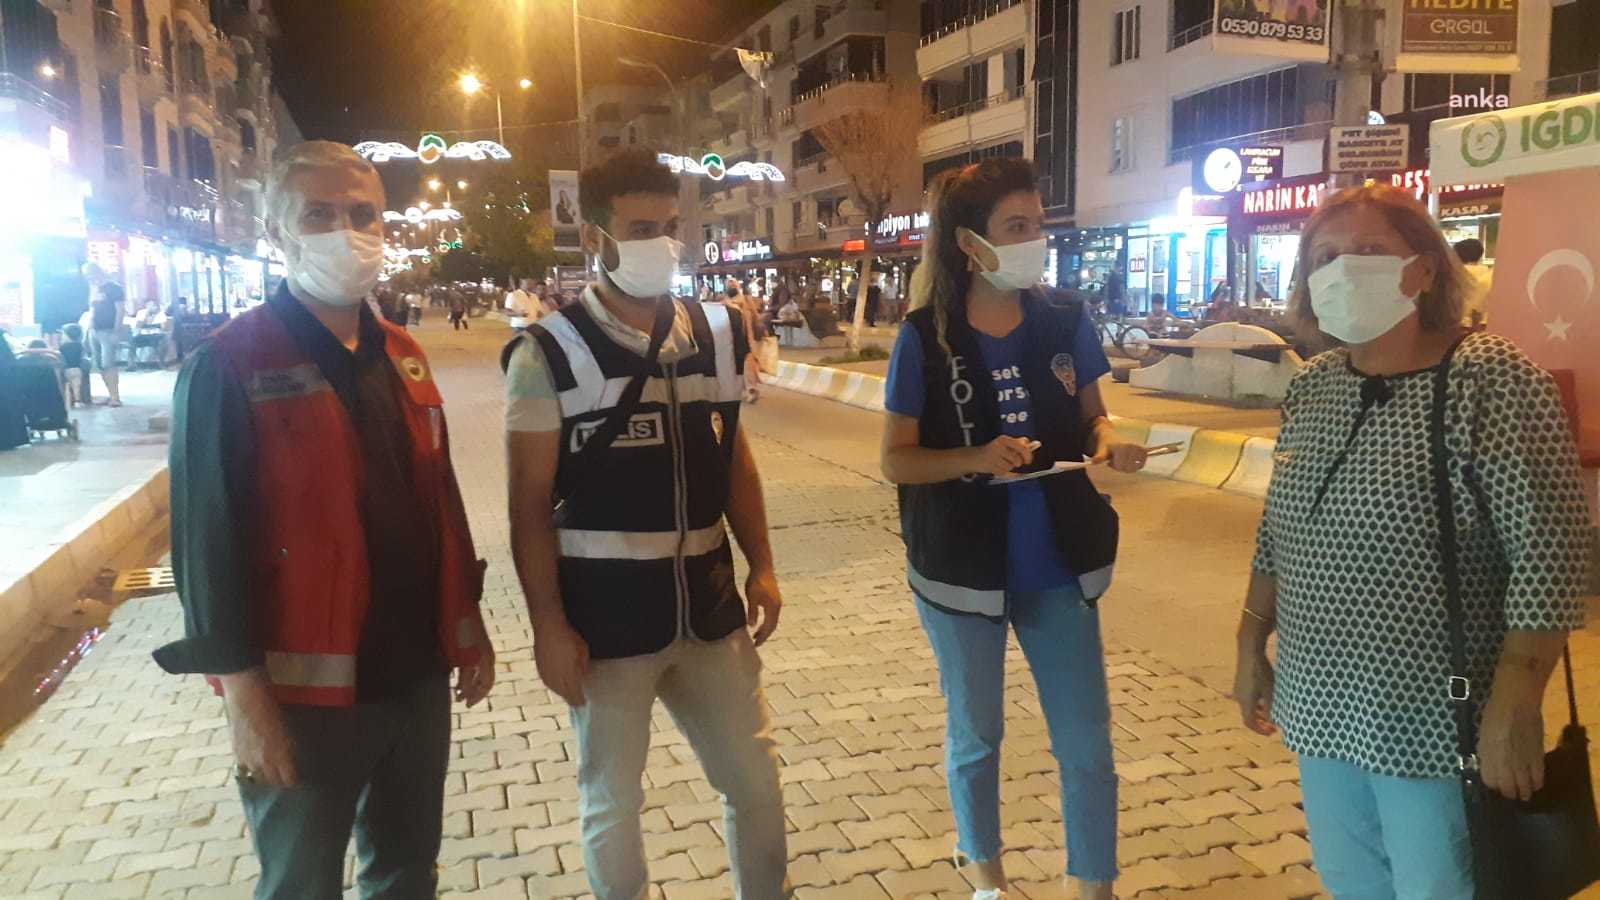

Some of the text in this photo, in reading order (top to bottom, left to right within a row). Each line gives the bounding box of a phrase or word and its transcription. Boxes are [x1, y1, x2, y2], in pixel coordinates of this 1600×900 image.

[1221, 18, 1322, 40] 0530 879 53 33
[1243, 183, 1292, 213] NARİN
[1441, 205, 1489, 216] KASAP
